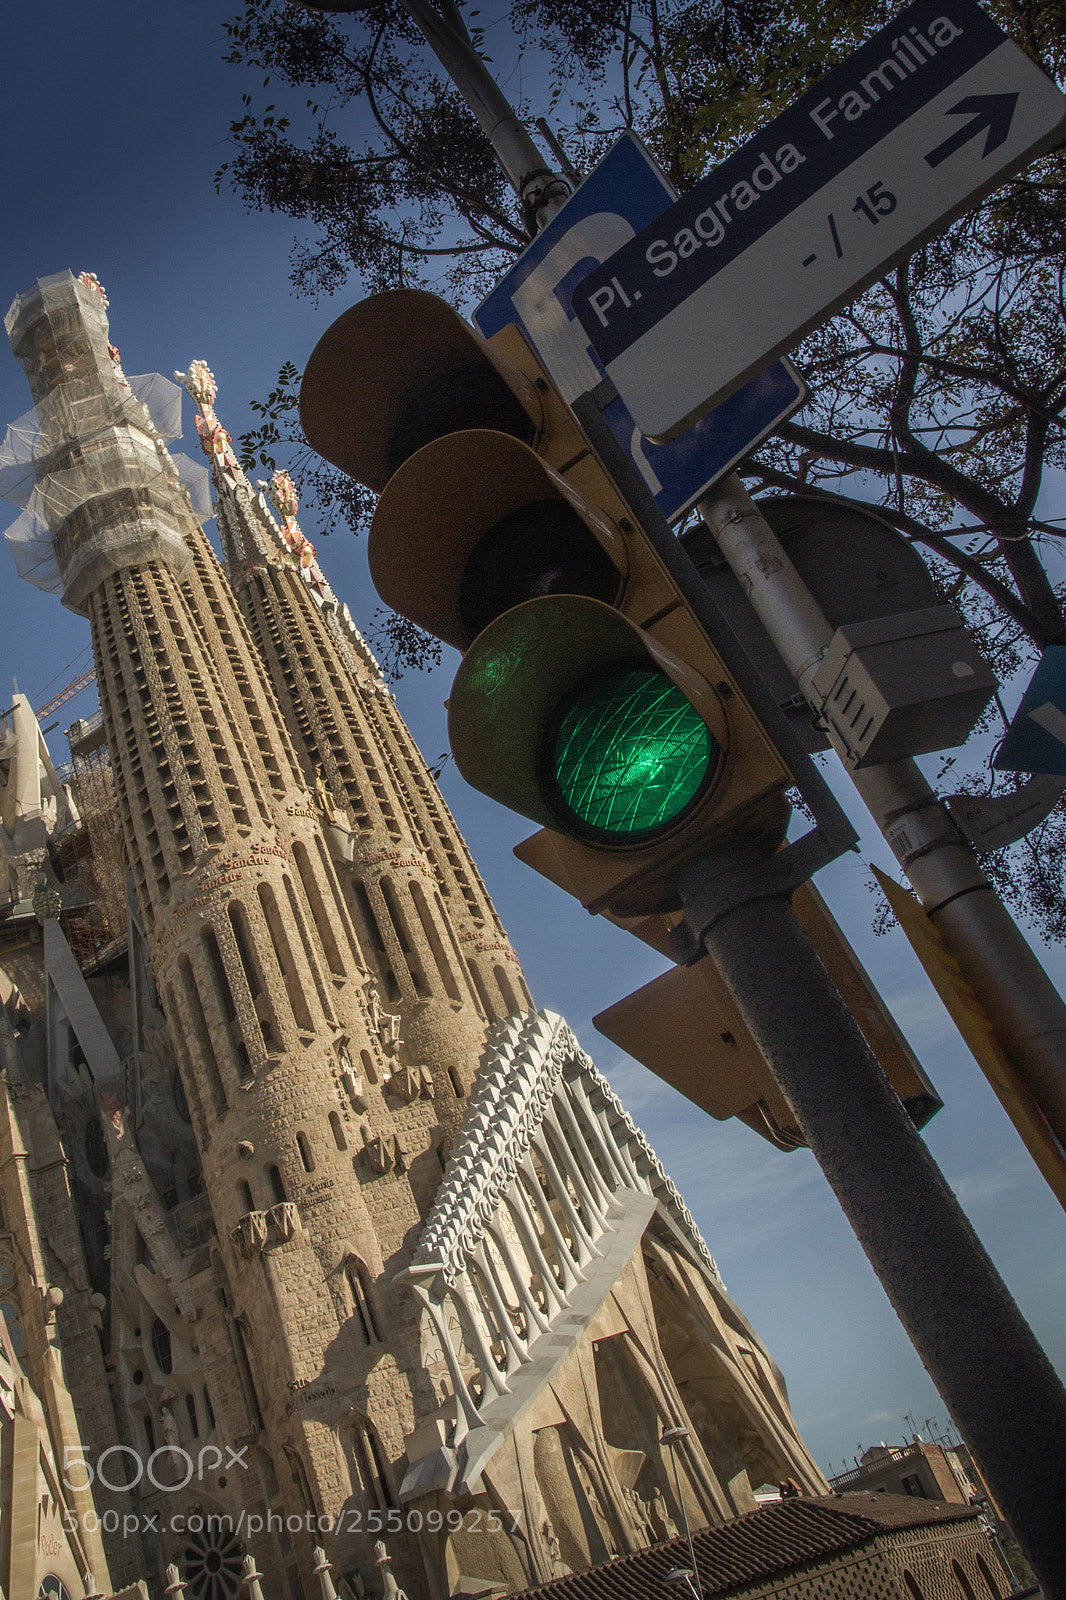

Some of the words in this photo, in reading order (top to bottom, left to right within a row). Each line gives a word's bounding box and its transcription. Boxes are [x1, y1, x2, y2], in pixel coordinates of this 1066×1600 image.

[587, 276, 643, 328] Pl.
[645, 141, 806, 278] Sagrada
[808, 15, 963, 141] Família
[852, 180, 898, 228] 15
[224, 855, 271, 870] Sanctus
[195, 870, 244, 891] Sanctus
[171, 894, 214, 921] Sanctus
